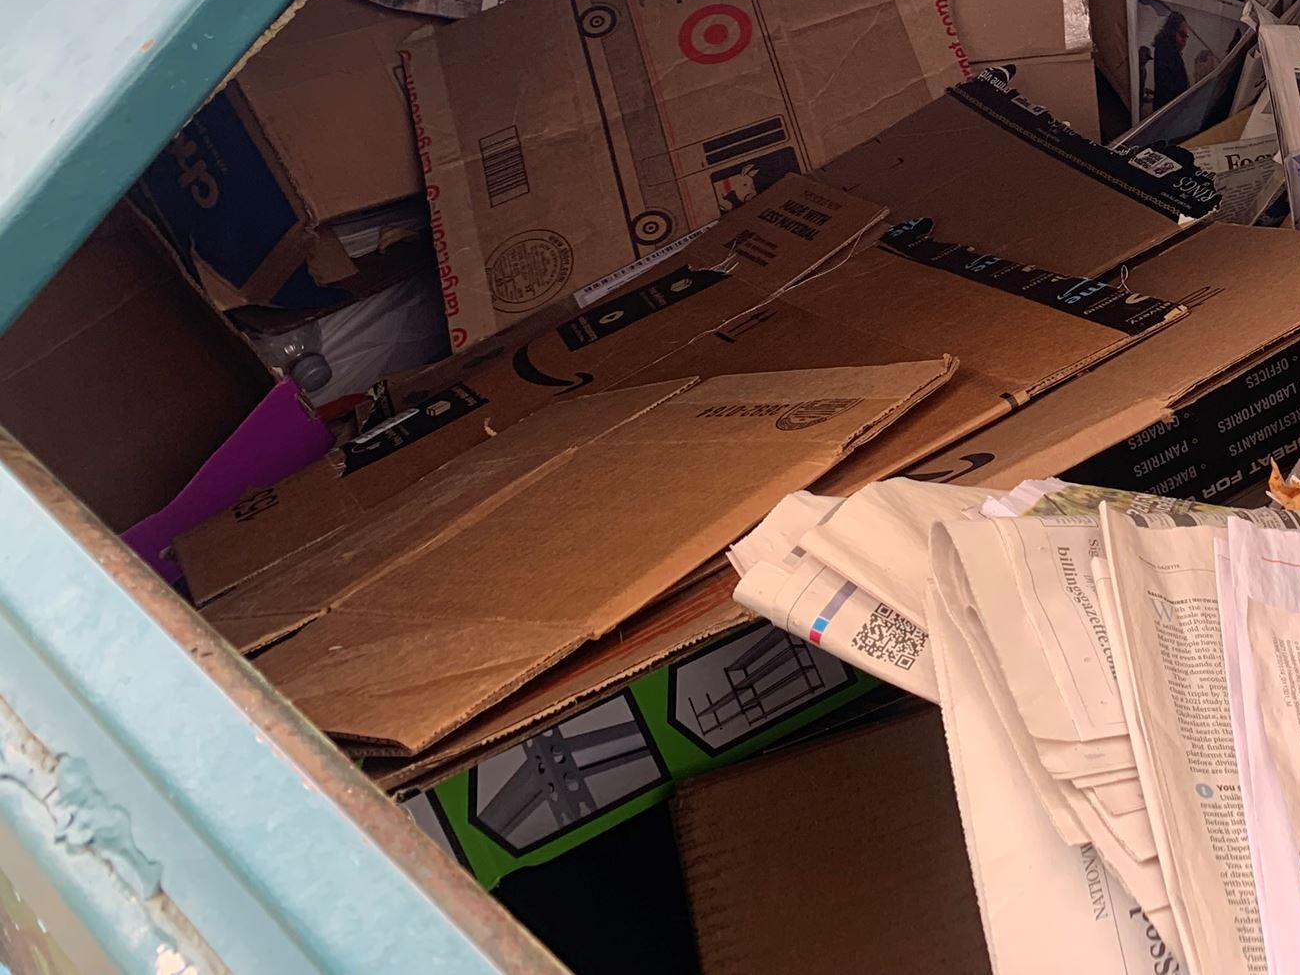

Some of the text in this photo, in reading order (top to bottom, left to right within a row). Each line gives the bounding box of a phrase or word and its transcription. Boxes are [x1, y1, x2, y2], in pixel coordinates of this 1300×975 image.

[1246, 357, 1289, 389] OFFICES
[1217, 381, 1297, 433] LABORATORIES
[1128, 418, 1180, 450] GARAGES
[1133, 440, 1189, 477] PANTRIES
[1143, 466, 1197, 496] BAKERIE
[1202, 471, 1243, 500] FOR
